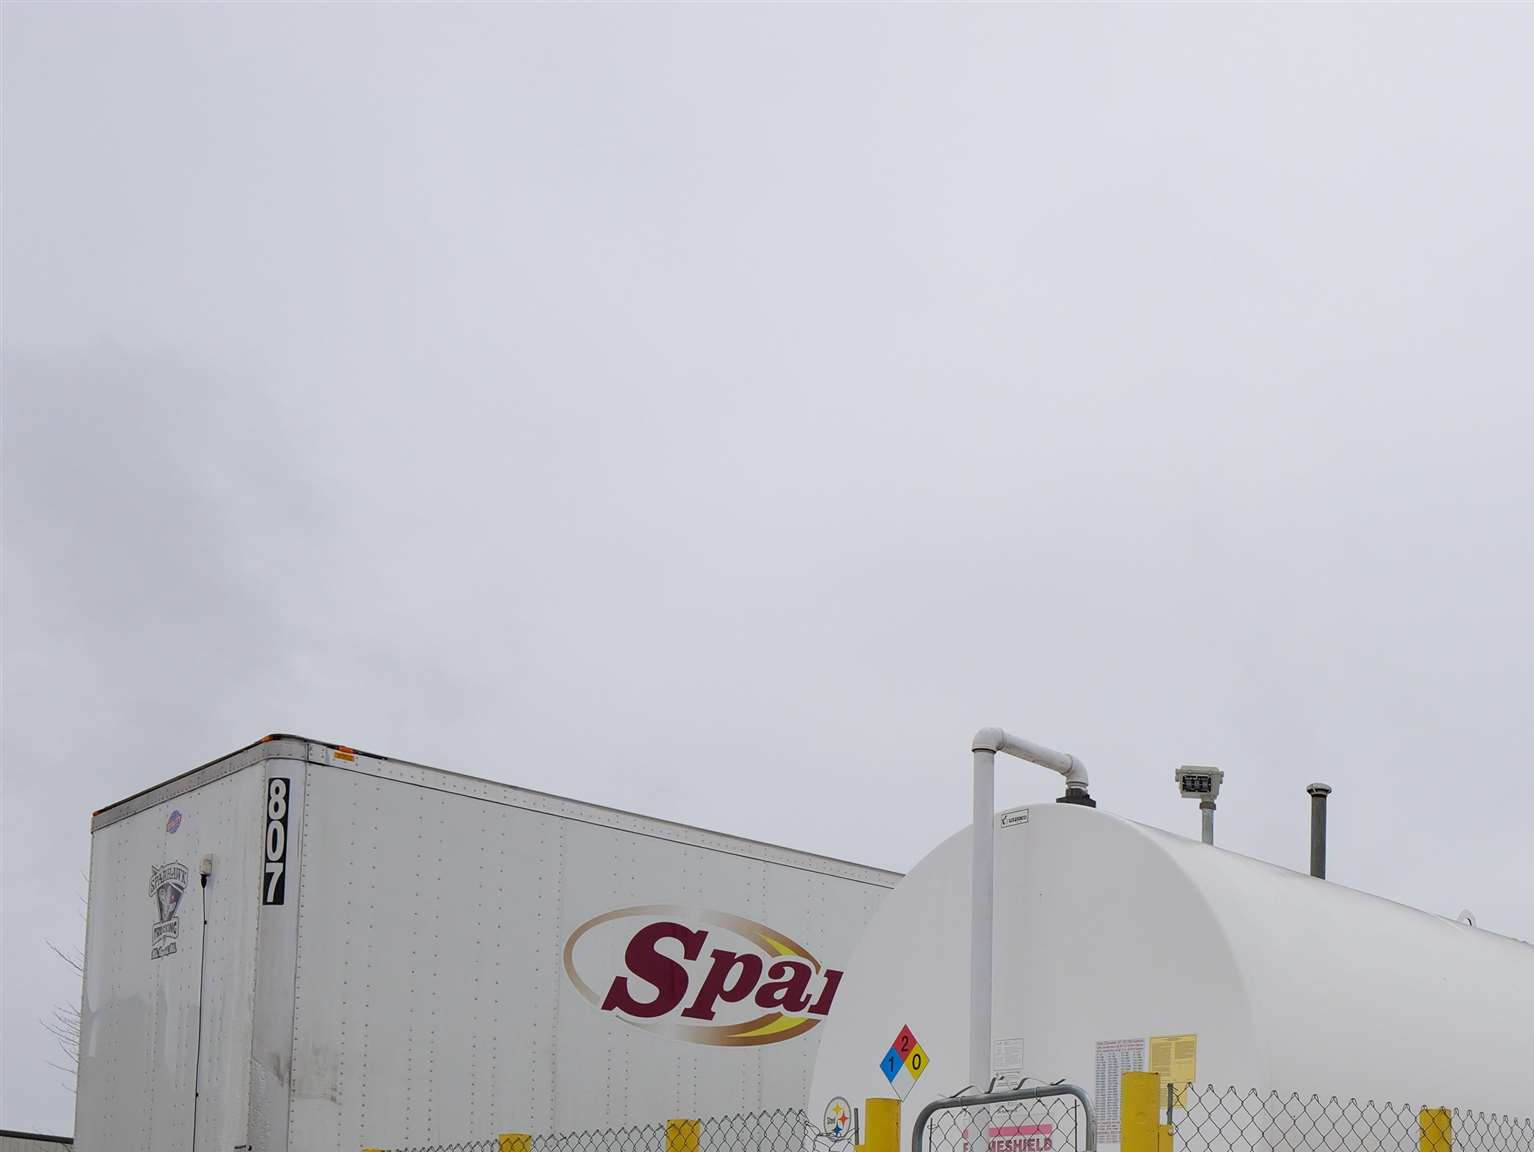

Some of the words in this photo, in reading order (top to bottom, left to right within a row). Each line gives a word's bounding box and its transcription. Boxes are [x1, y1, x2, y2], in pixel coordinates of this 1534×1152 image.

[265, 779, 286, 903] 807
[901, 1036, 909, 1052] 2
[888, 1056, 895, 1072] 1
[912, 1053, 922, 1070] 0
